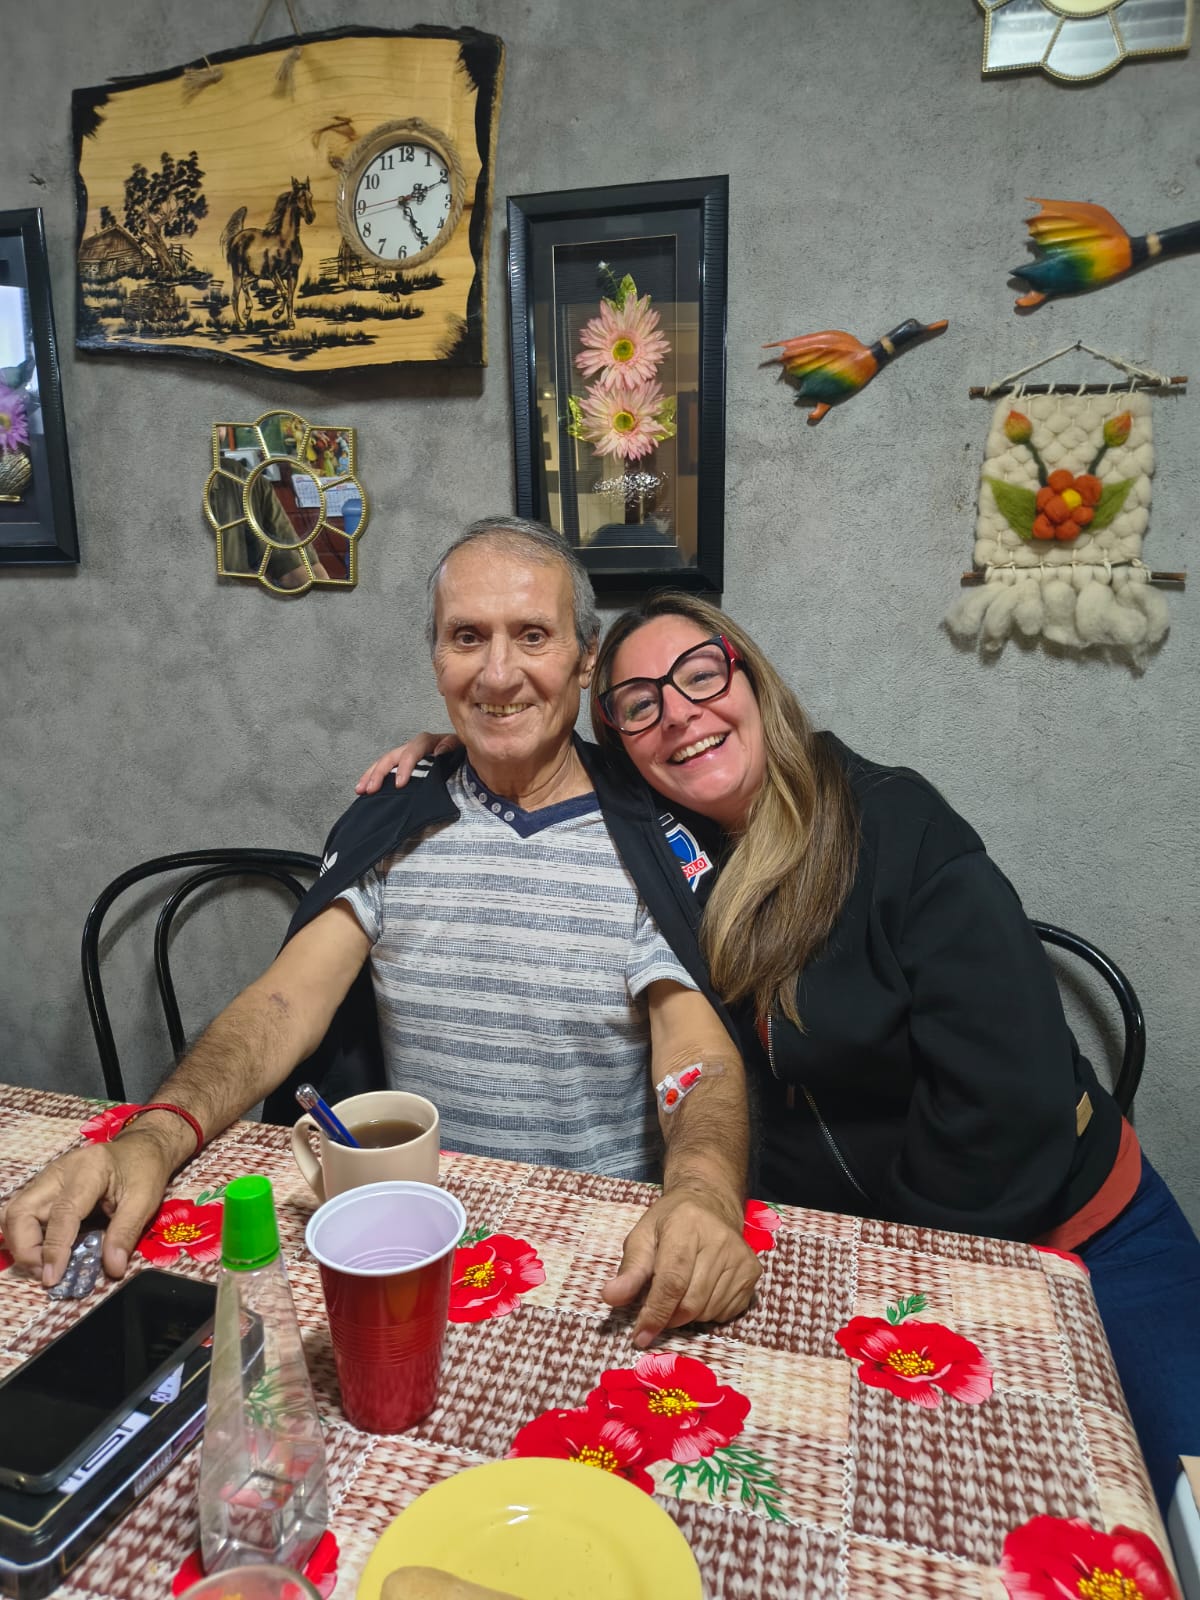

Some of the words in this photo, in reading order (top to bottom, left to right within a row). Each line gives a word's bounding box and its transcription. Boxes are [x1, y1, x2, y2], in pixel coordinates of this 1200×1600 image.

[398, 146, 415, 162] 12
[424, 152, 432, 167] 1
[380, 155, 395, 171] 11
[364, 173, 380, 190] 10
[439, 168, 449, 184] 2
[357, 200, 366, 215] 9
[445, 194, 452, 209] 3
[362, 222, 372, 238] 8
[378, 238, 387, 255] 7
[398, 246, 407, 259] 6
